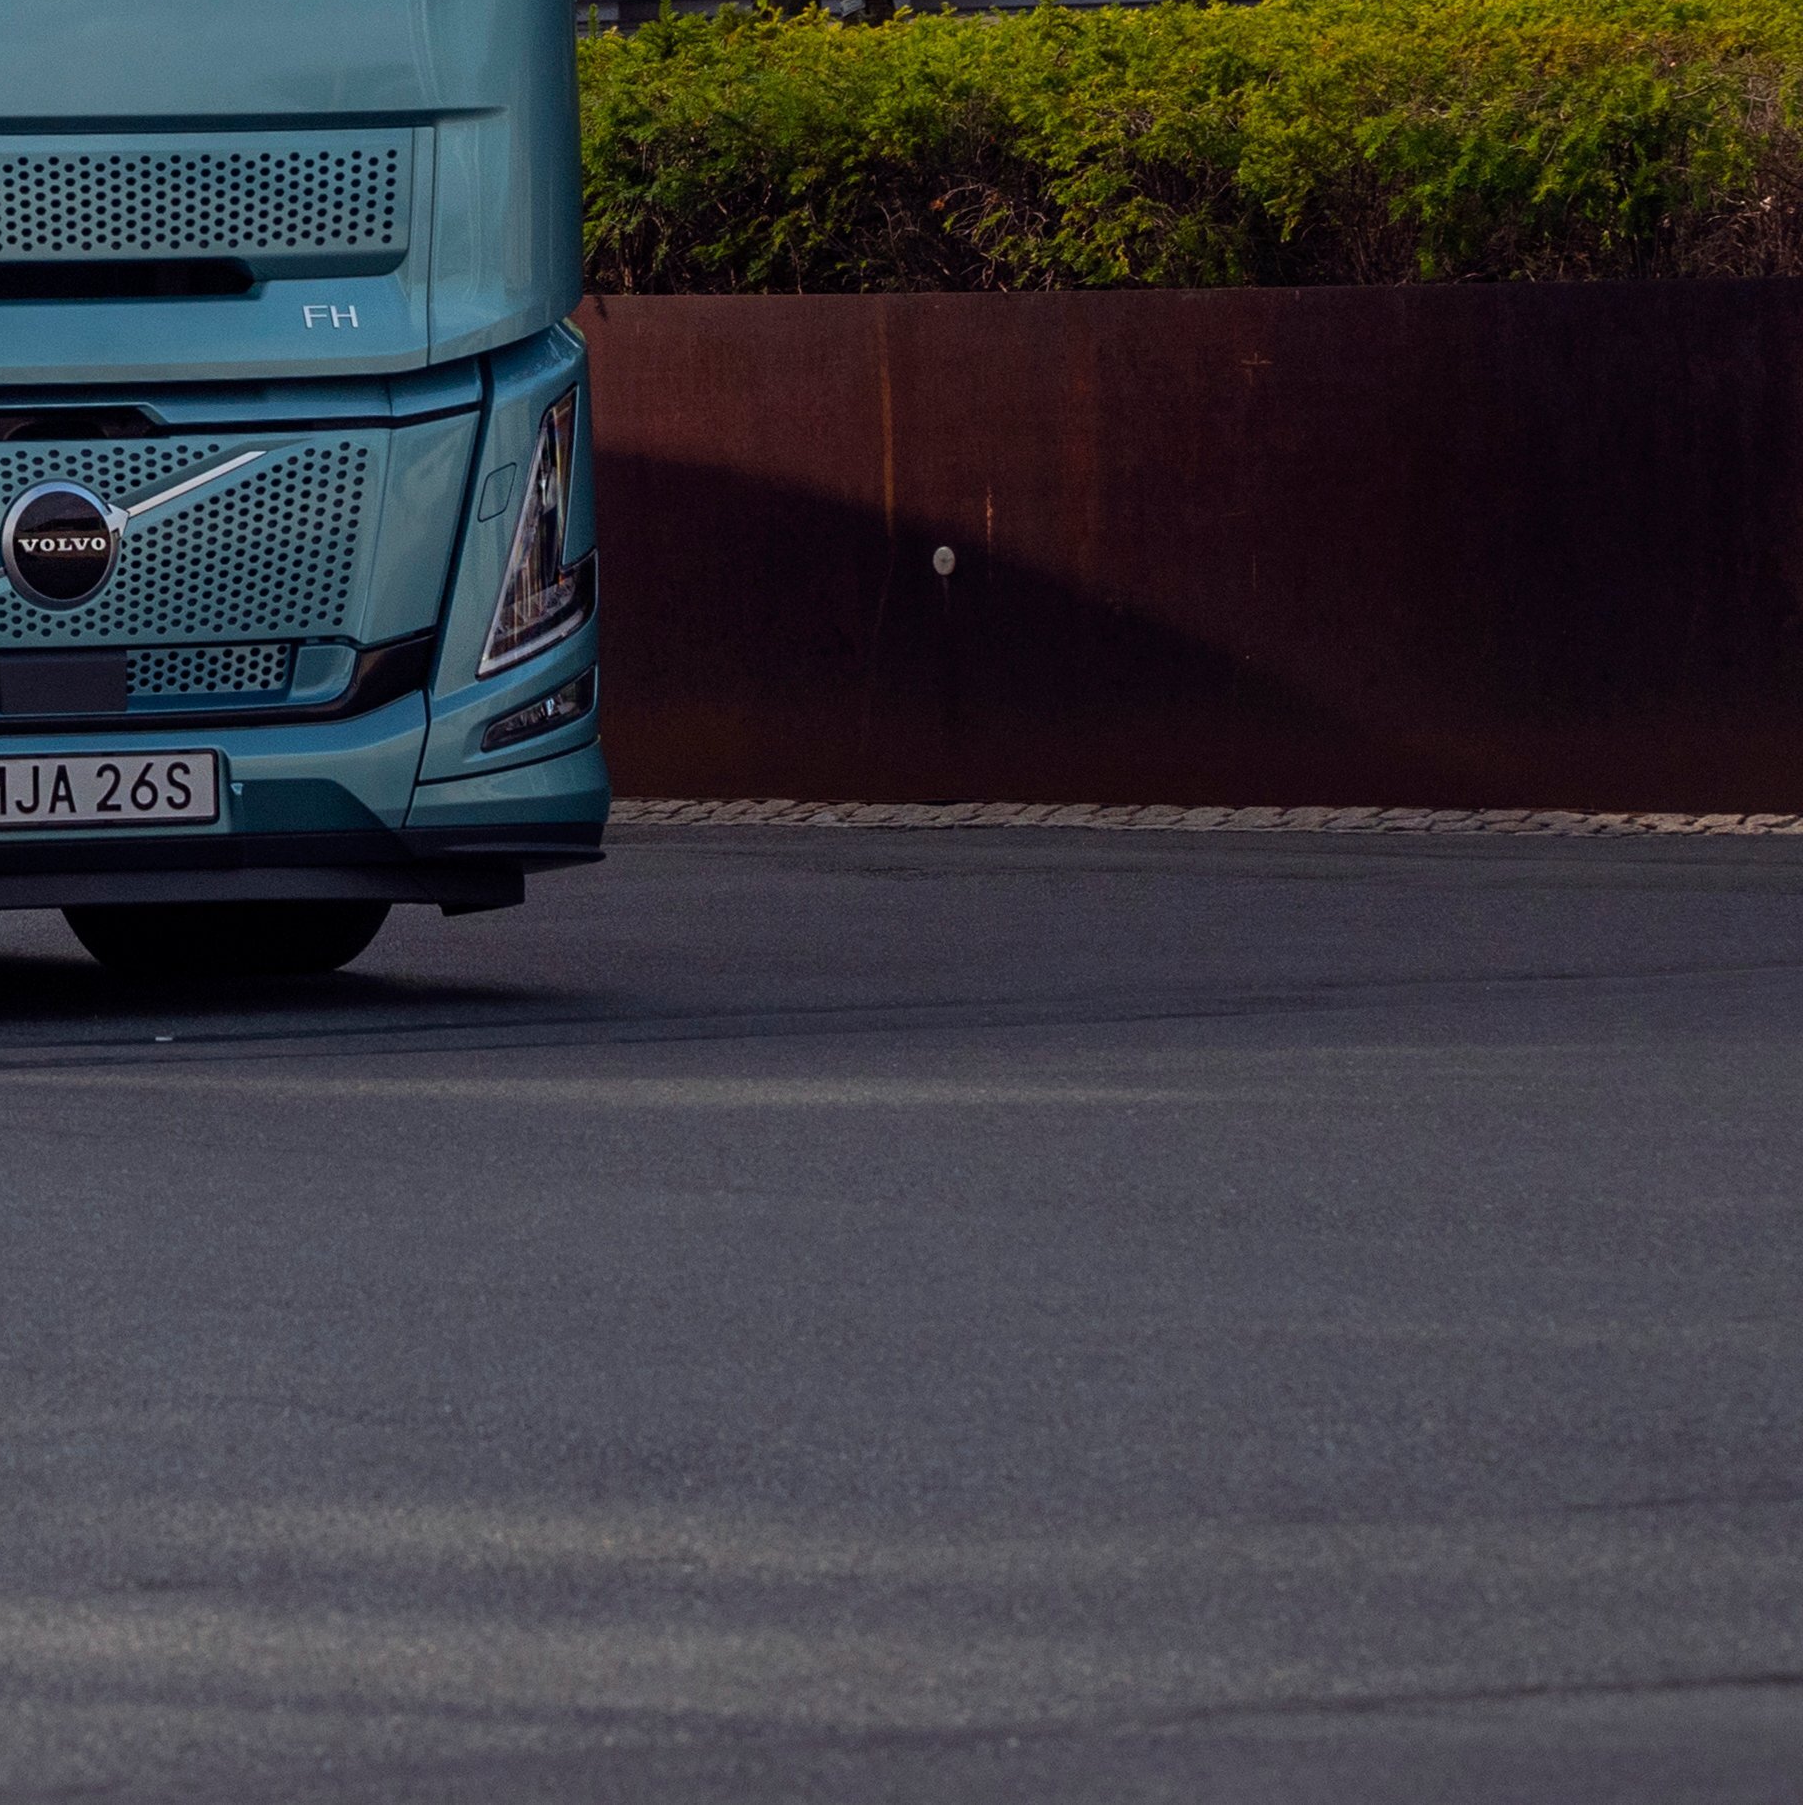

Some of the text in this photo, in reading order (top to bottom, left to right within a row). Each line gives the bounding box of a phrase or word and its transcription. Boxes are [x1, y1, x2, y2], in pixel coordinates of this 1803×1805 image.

[302, 305, 359, 328] FH
[18, 536, 107, 553] VOLVO
[95, 761, 192, 812] 26S
